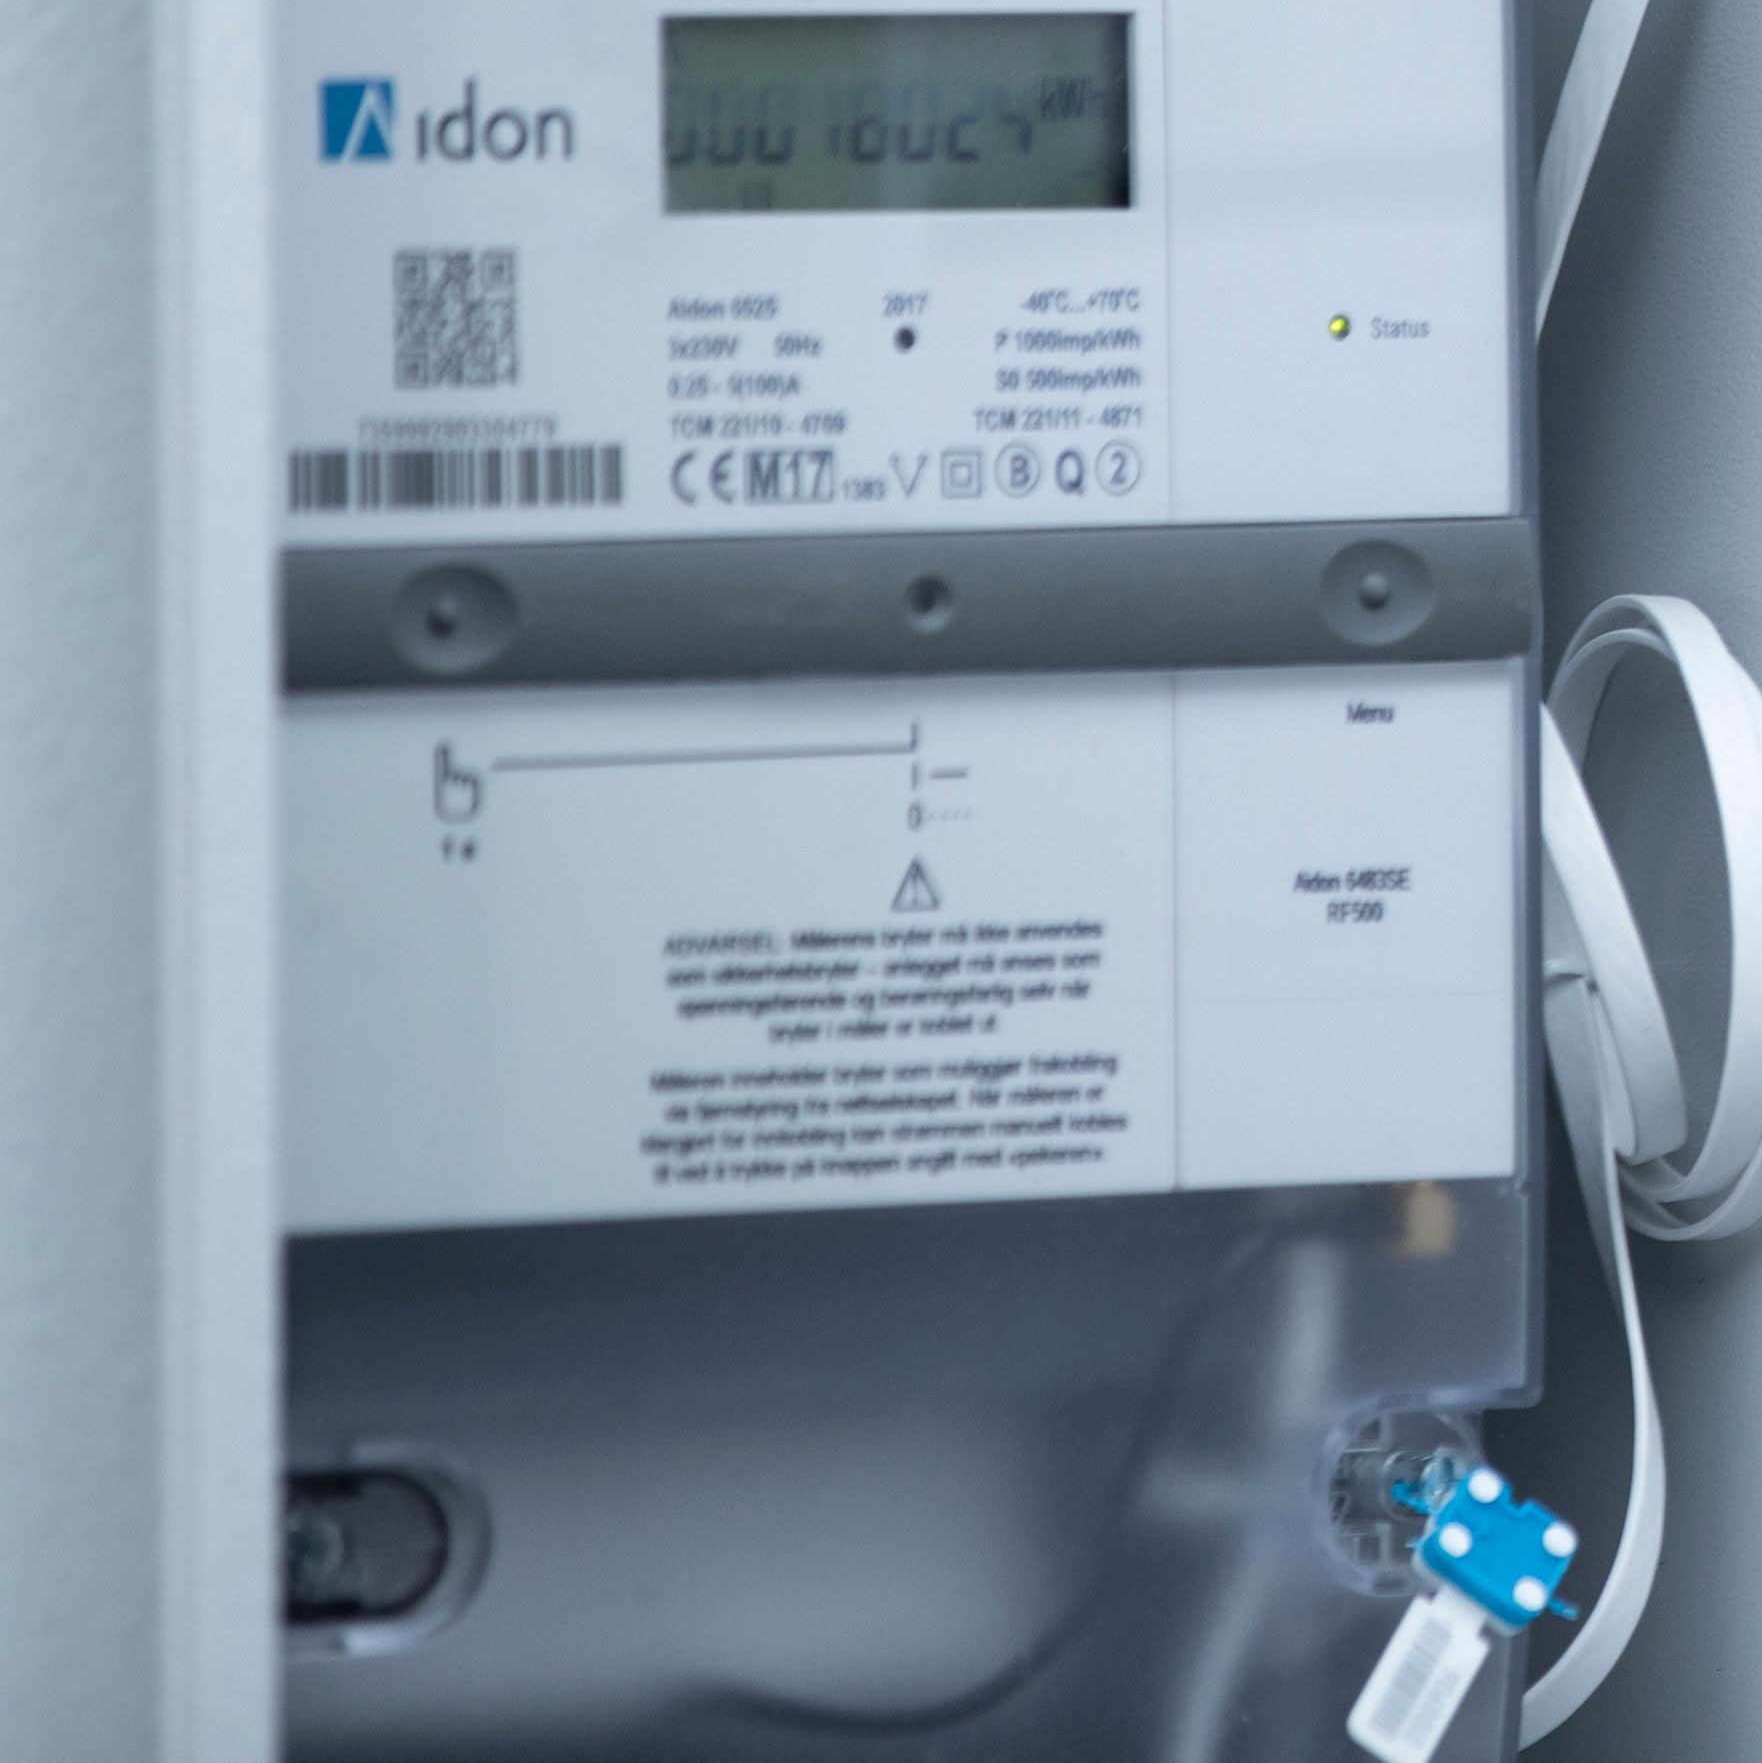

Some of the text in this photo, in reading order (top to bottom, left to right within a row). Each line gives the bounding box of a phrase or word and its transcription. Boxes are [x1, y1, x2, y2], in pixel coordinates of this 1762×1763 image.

[666, 294, 726, 320] Aidon
[880, 289, 930, 318] 2017
[1370, 317, 1430, 340] Status
[773, 332, 824, 358] 50Hz
[1014, 328, 1141, 356] 1000imp/kWh
[1025, 367, 1141, 395] 500imp/kWh
[669, 413, 713, 439] TCM
[973, 406, 1016, 432] TCM
[750, 450, 833, 501] M17
[1055, 448, 1085, 496] Q
[1346, 702, 1395, 724] Menu
[1293, 870, 1341, 895] Aidon
[1326, 900, 1384, 925] RF500
